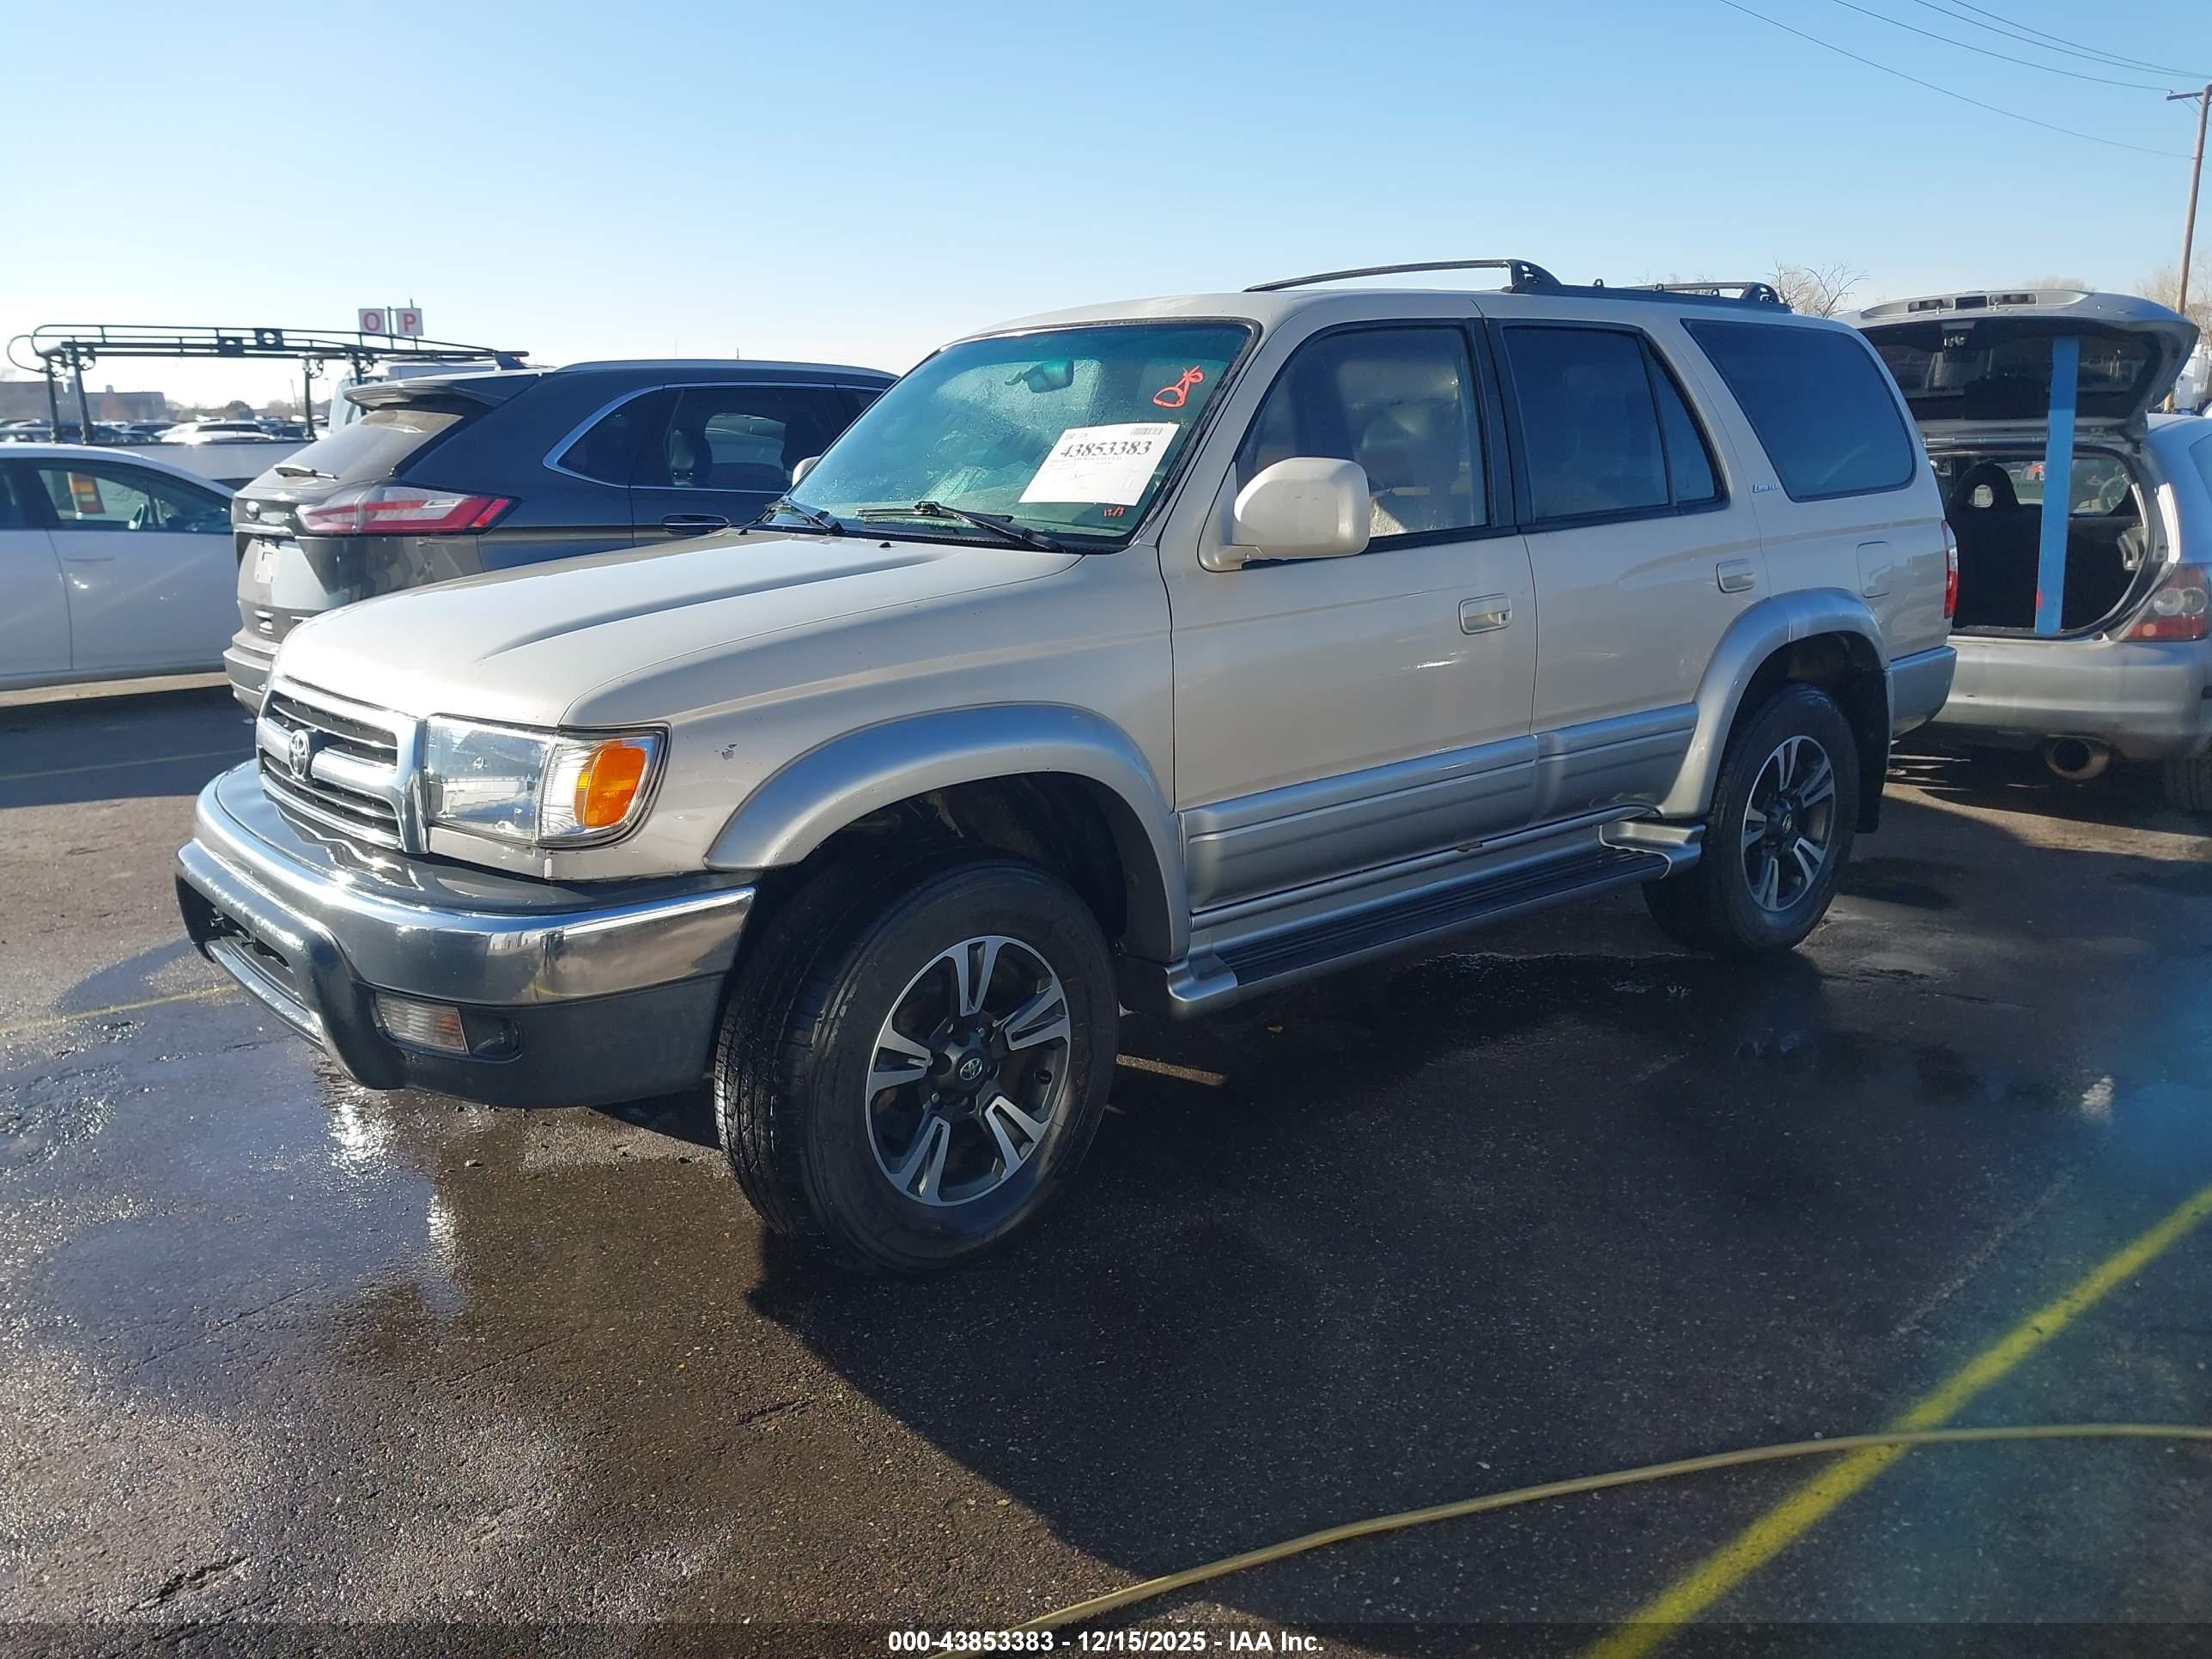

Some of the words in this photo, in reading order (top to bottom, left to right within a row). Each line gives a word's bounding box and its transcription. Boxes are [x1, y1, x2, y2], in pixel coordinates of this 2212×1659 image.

[363, 312, 380, 331] O
[403, 313, 416, 331] P
[1060, 441, 1152, 458] 43853383
